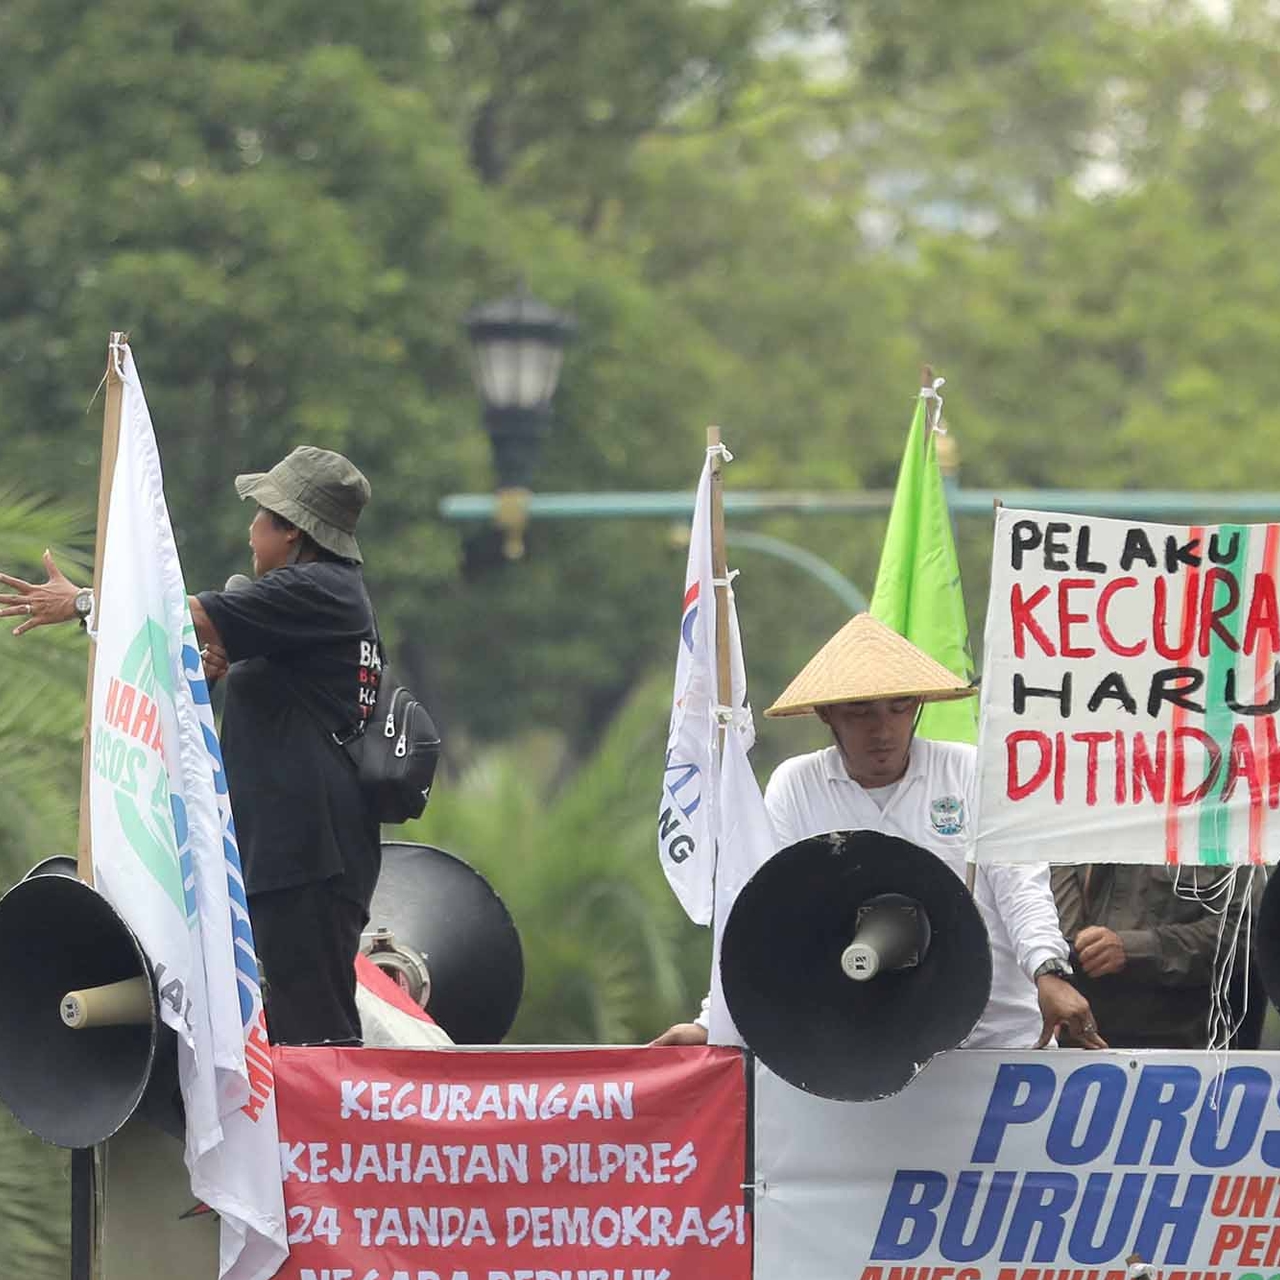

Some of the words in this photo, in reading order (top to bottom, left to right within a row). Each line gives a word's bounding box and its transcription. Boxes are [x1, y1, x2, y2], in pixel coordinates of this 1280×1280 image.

[1011, 520, 1240, 574] PELAKU
[340, 1080, 635, 1122] KECURANGAN
[280, 1141, 529, 1184] KEJAHATAN
[541, 1141, 698, 1184] PILPRES
[355, 1206, 496, 1247] TANDA
[506, 1204, 746, 1247] DEMOKRASI
[870, 1169, 1215, 1266] BURUH
